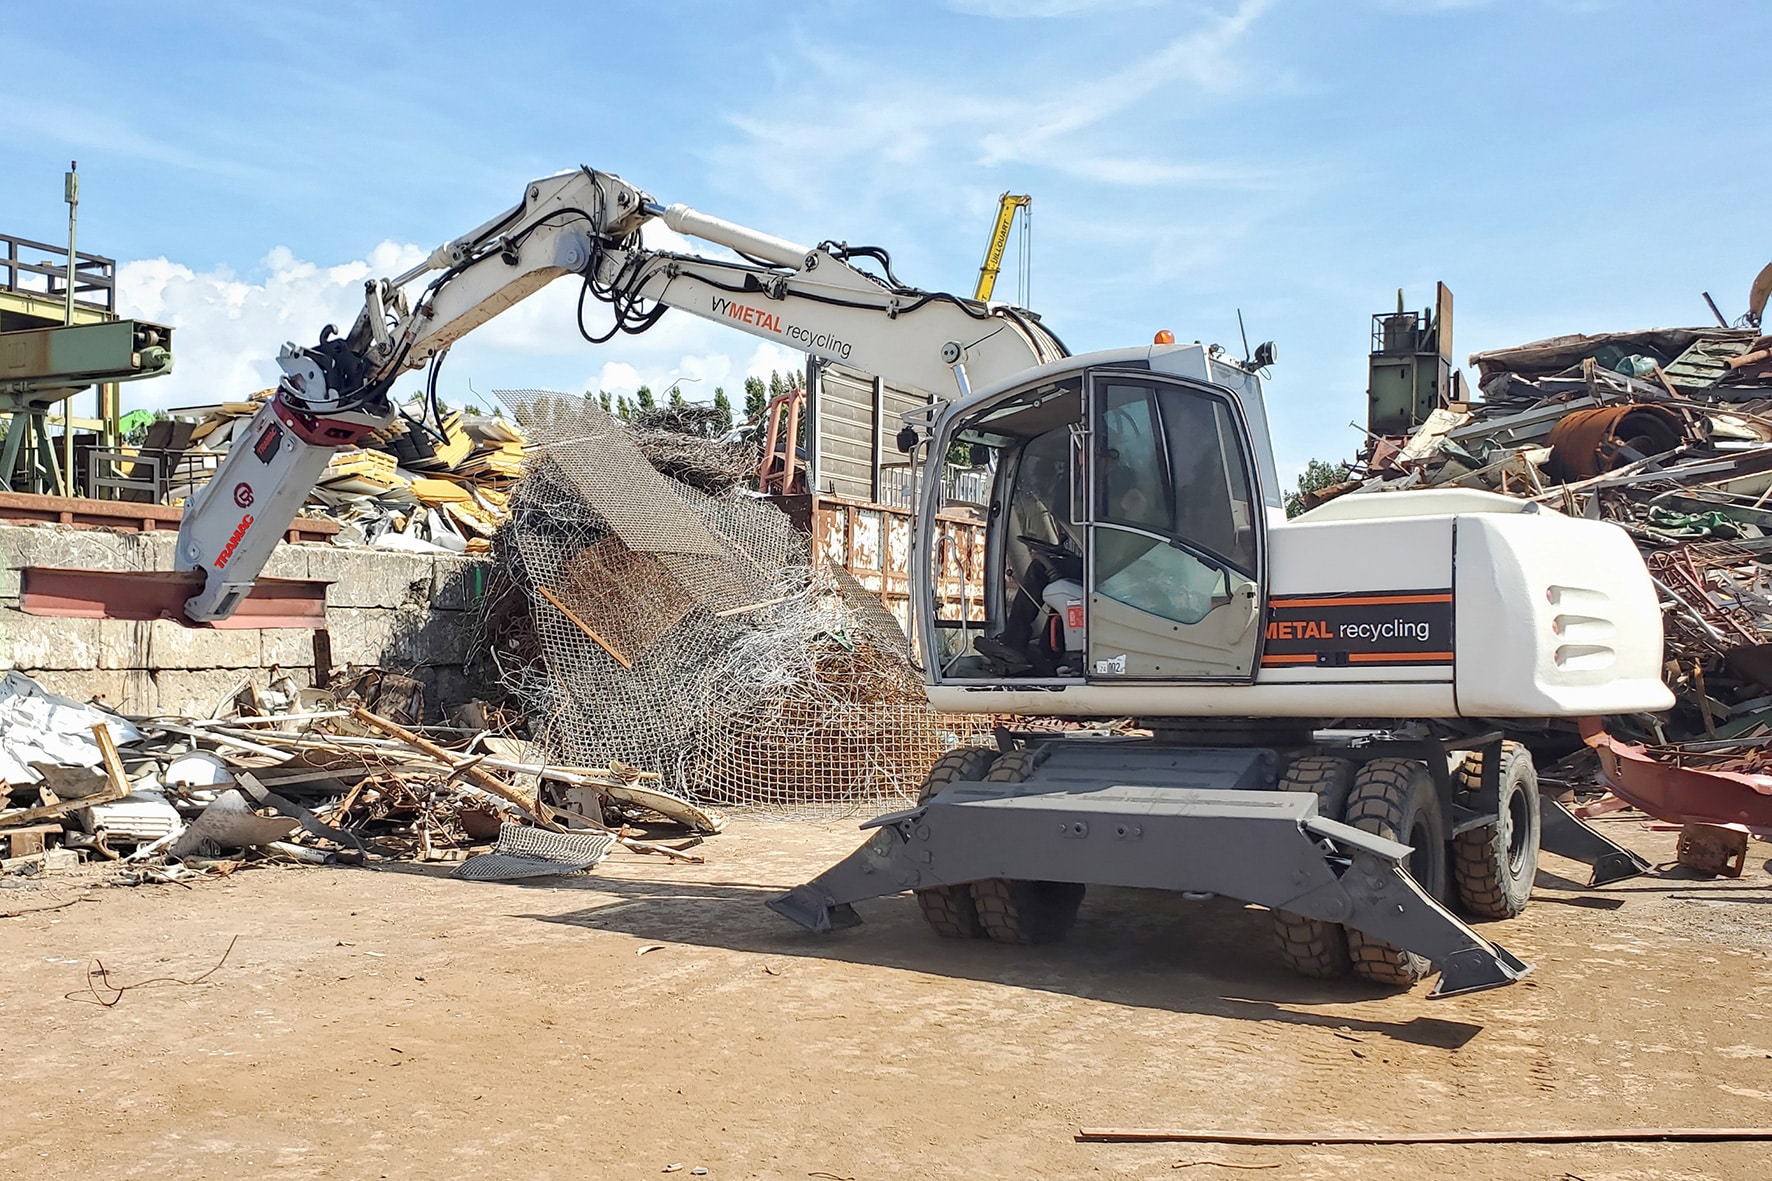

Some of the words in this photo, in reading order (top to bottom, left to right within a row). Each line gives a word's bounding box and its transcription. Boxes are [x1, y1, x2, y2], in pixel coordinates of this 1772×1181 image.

[711, 295, 782, 333] VYMETAL
[785, 324, 852, 360] recycling
[213, 513, 254, 569] TRAMAC
[1339, 619, 1430, 642] recycling
